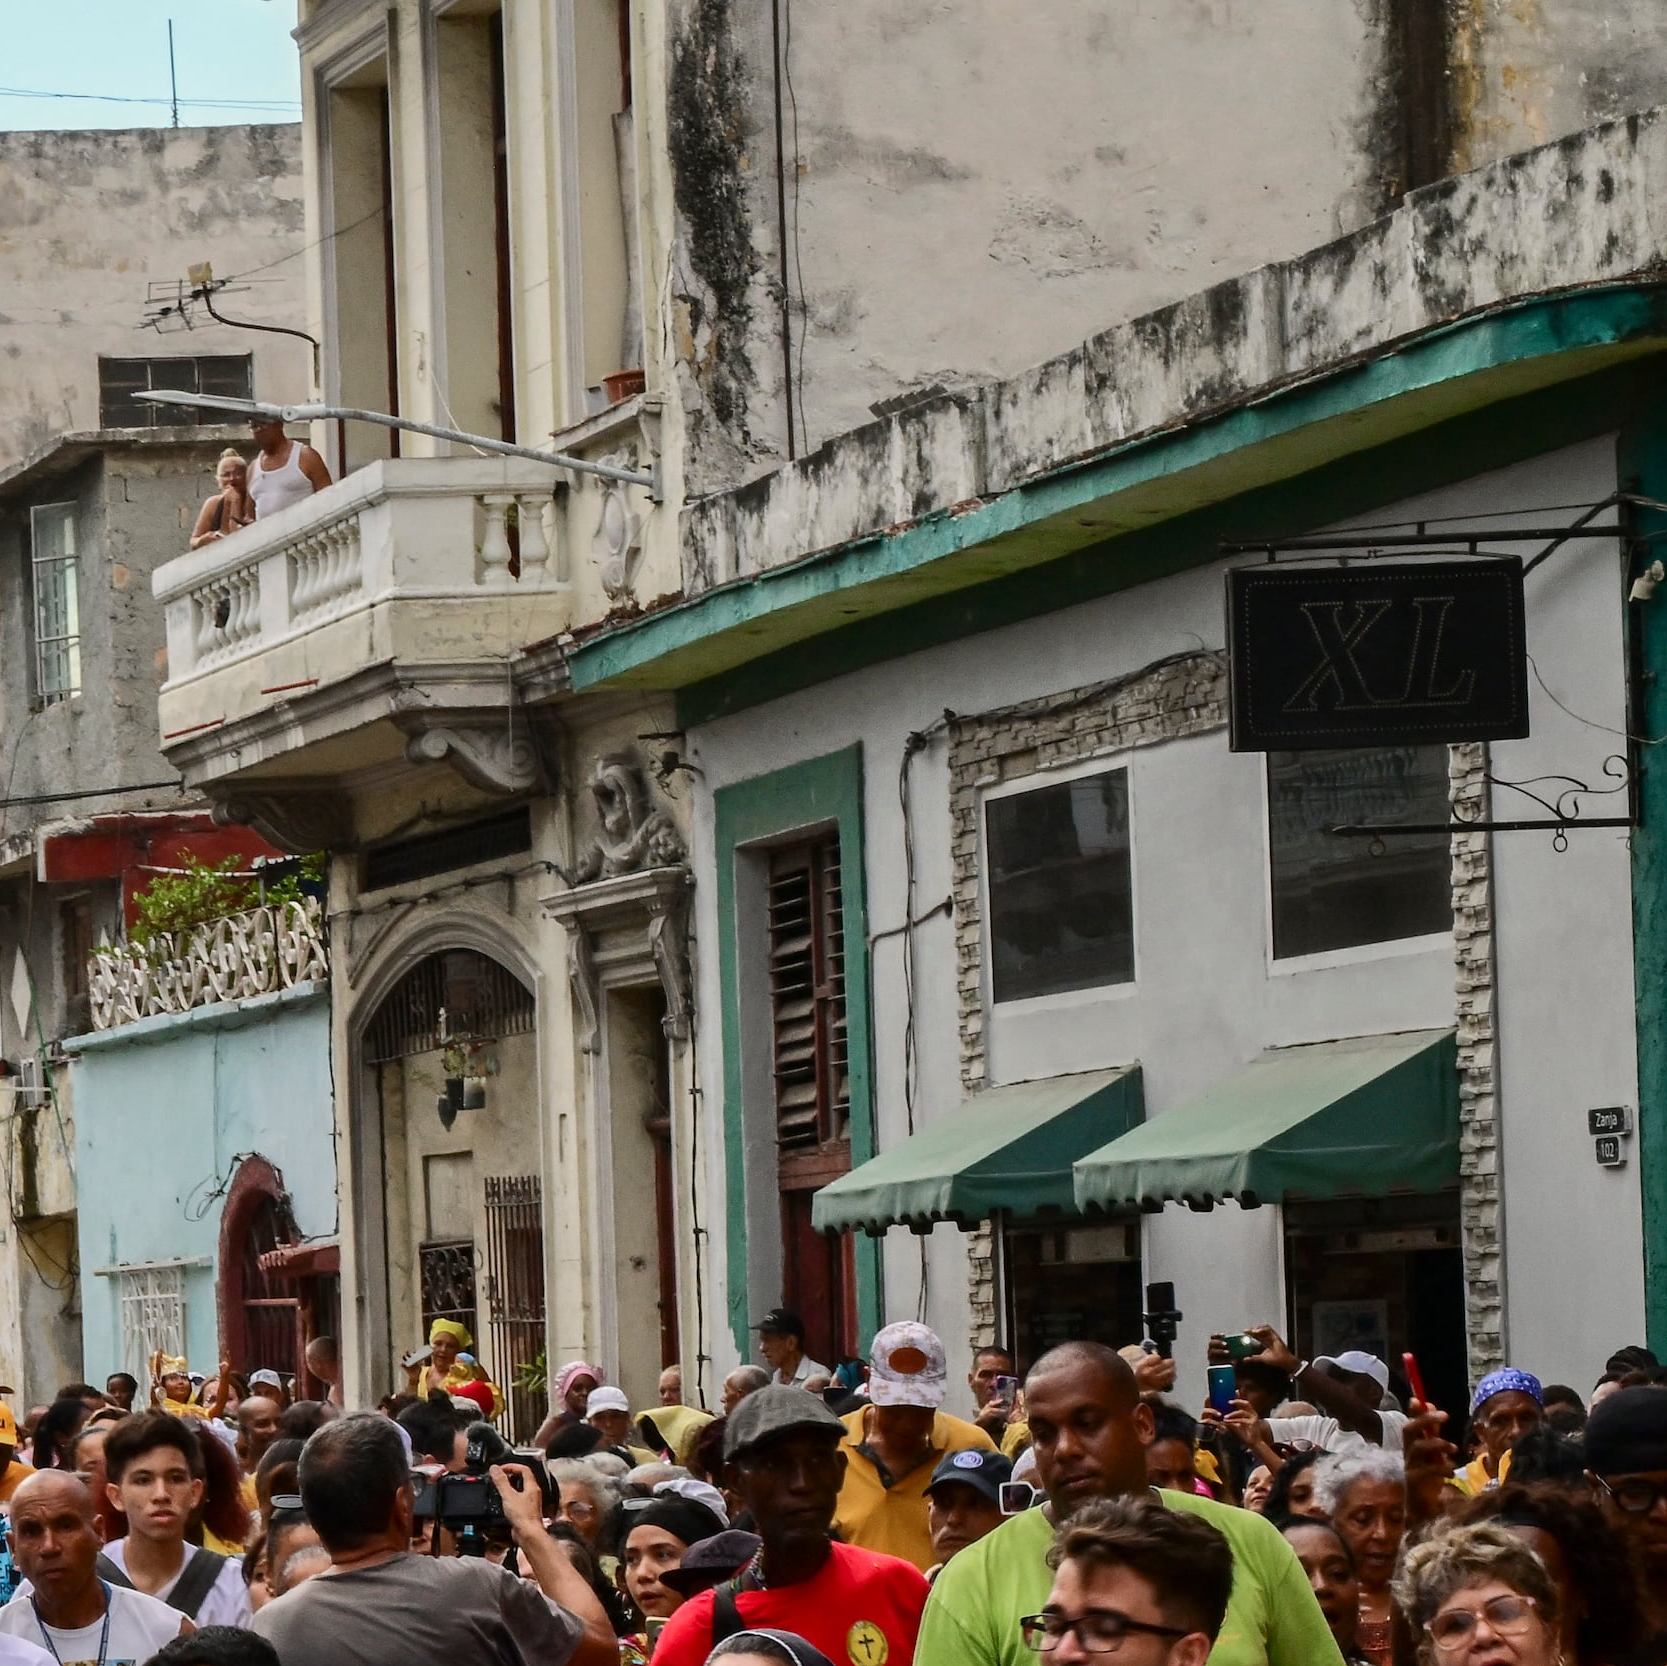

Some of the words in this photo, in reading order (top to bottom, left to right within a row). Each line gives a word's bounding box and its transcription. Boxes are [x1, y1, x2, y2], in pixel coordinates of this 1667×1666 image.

[1282, 594, 1477, 712] XL
[1595, 1111, 1618, 1130] Zanja
[1601, 1142, 1615, 1158] 102
